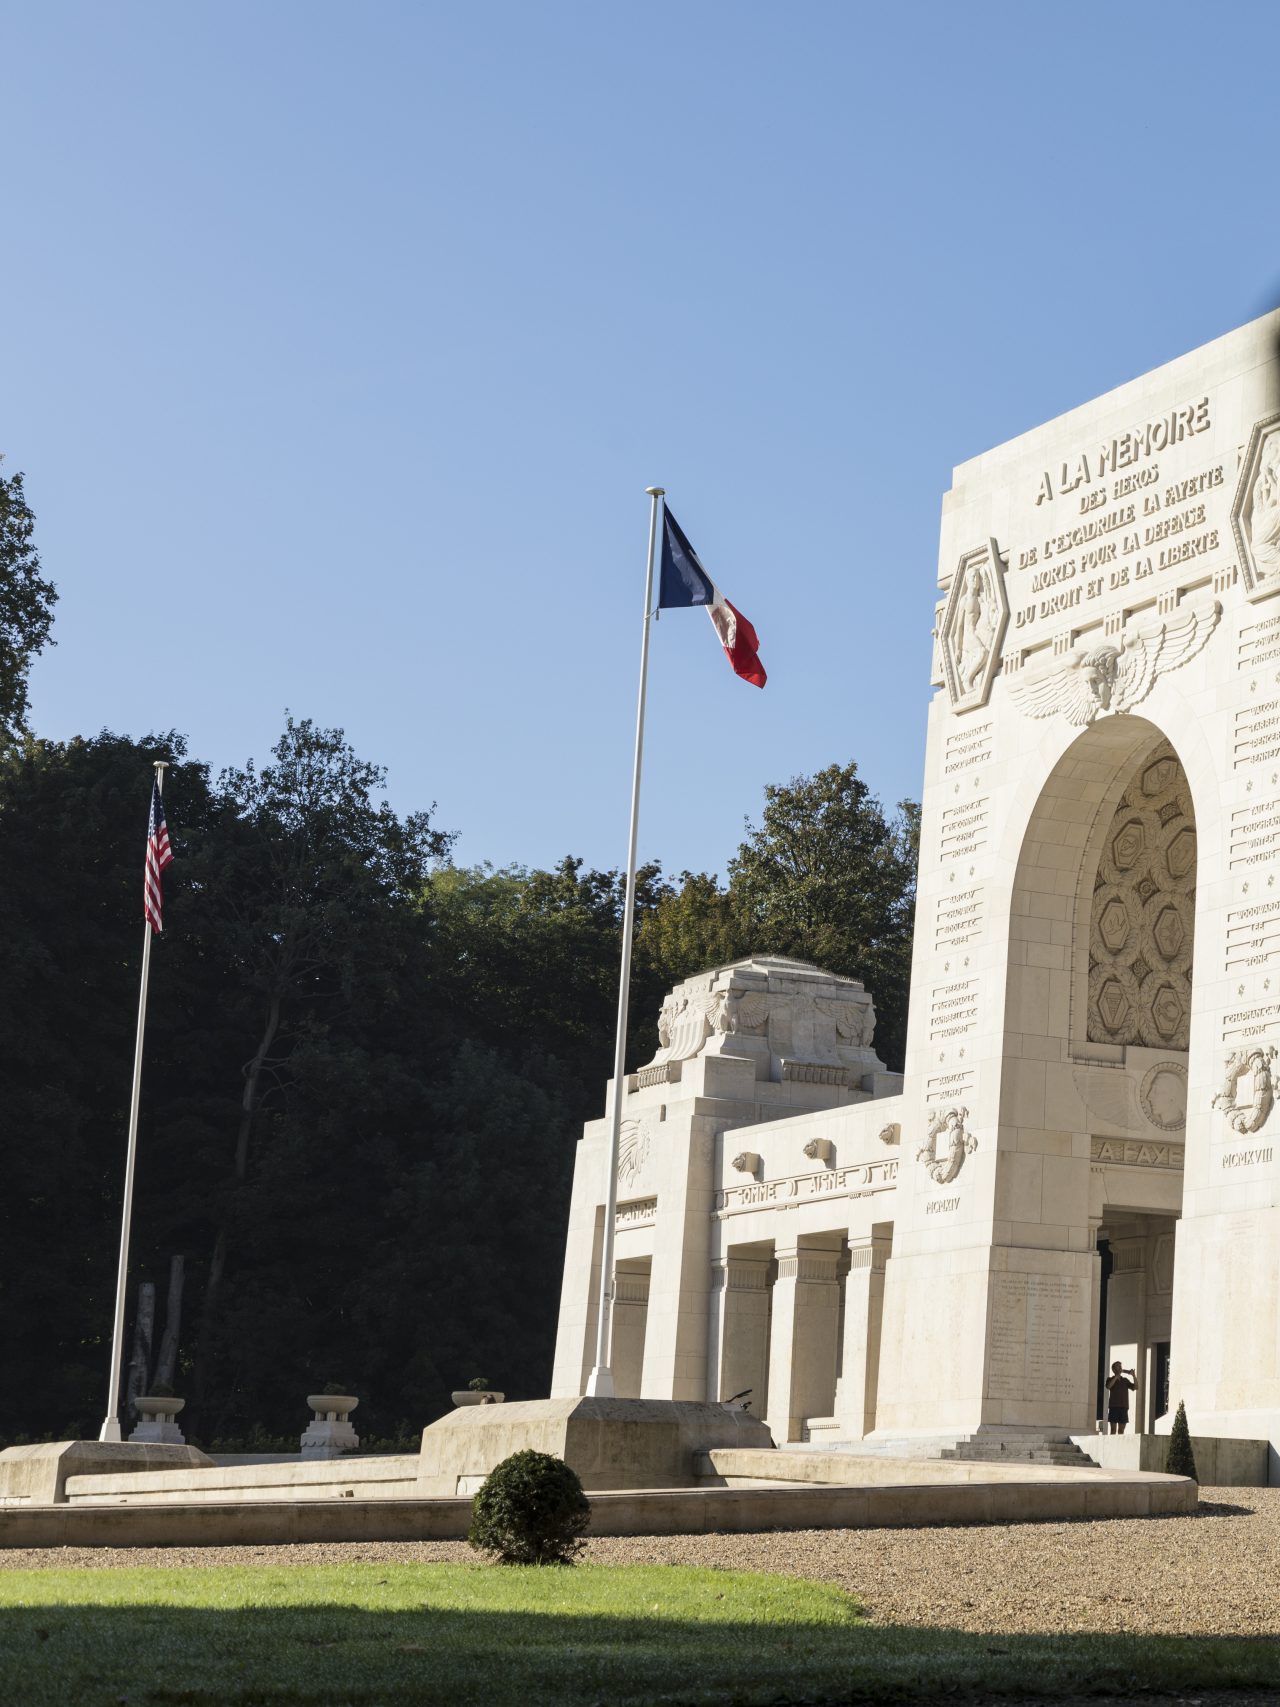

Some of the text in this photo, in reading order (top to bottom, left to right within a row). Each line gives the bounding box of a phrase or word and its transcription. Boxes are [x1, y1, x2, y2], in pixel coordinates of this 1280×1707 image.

[1035, 397, 1211, 505] A LA MEMOIRE
[1079, 463, 1160, 515] DES HEROS
[1018, 465, 1224, 570] DE L'ESCADRILLE LA FAYETTE
[1031, 504, 1207, 593] MORTS POUR LA DEFENSE
[1015, 529, 1220, 629] DU DROIT ET DE LA LIBERTE
[737, 1185, 776, 1204] SOMME
[810, 1172, 847, 1193] AISNE
[1222, 1147, 1273, 1169] MCMXVIII
